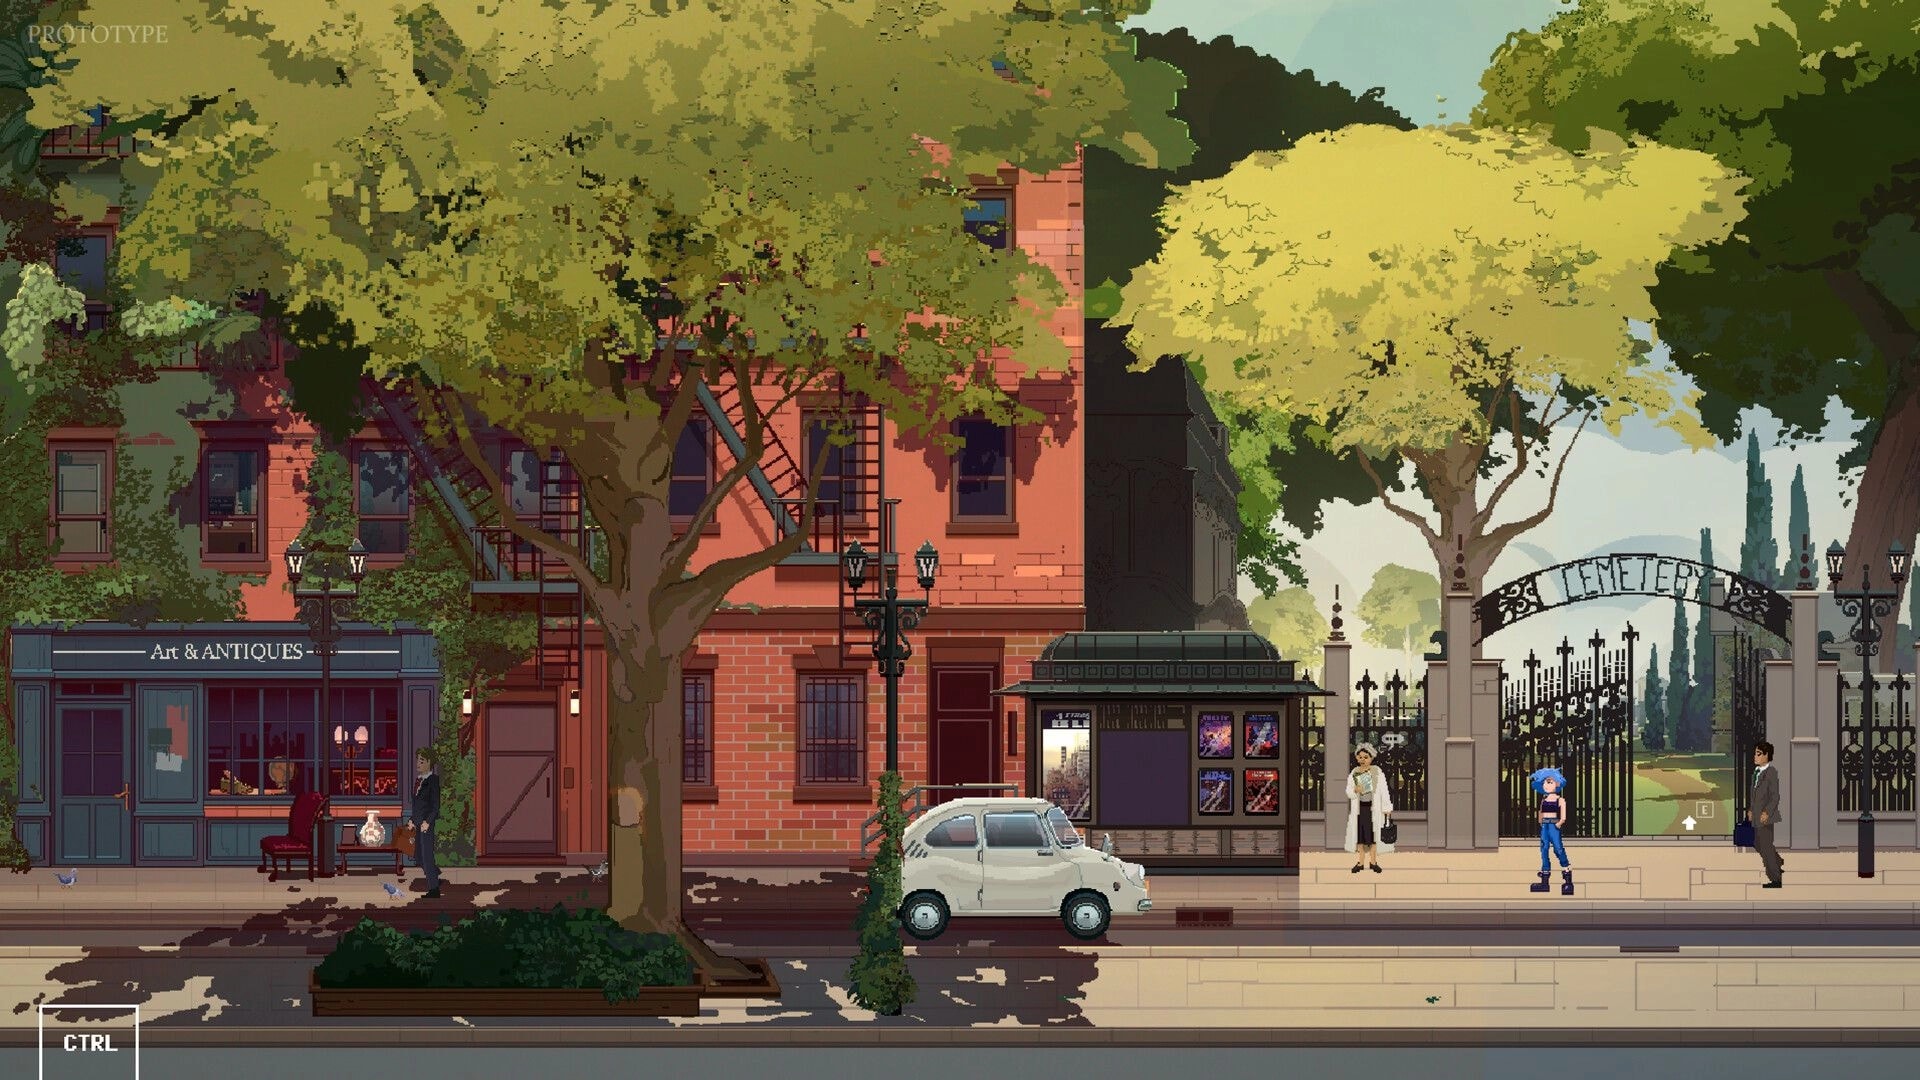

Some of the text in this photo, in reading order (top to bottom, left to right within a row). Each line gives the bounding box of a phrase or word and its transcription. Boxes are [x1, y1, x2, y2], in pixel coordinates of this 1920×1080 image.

[1562, 556, 1711, 602] CEMETERY
[150, 643, 304, 663] Art & ANTIQUES
